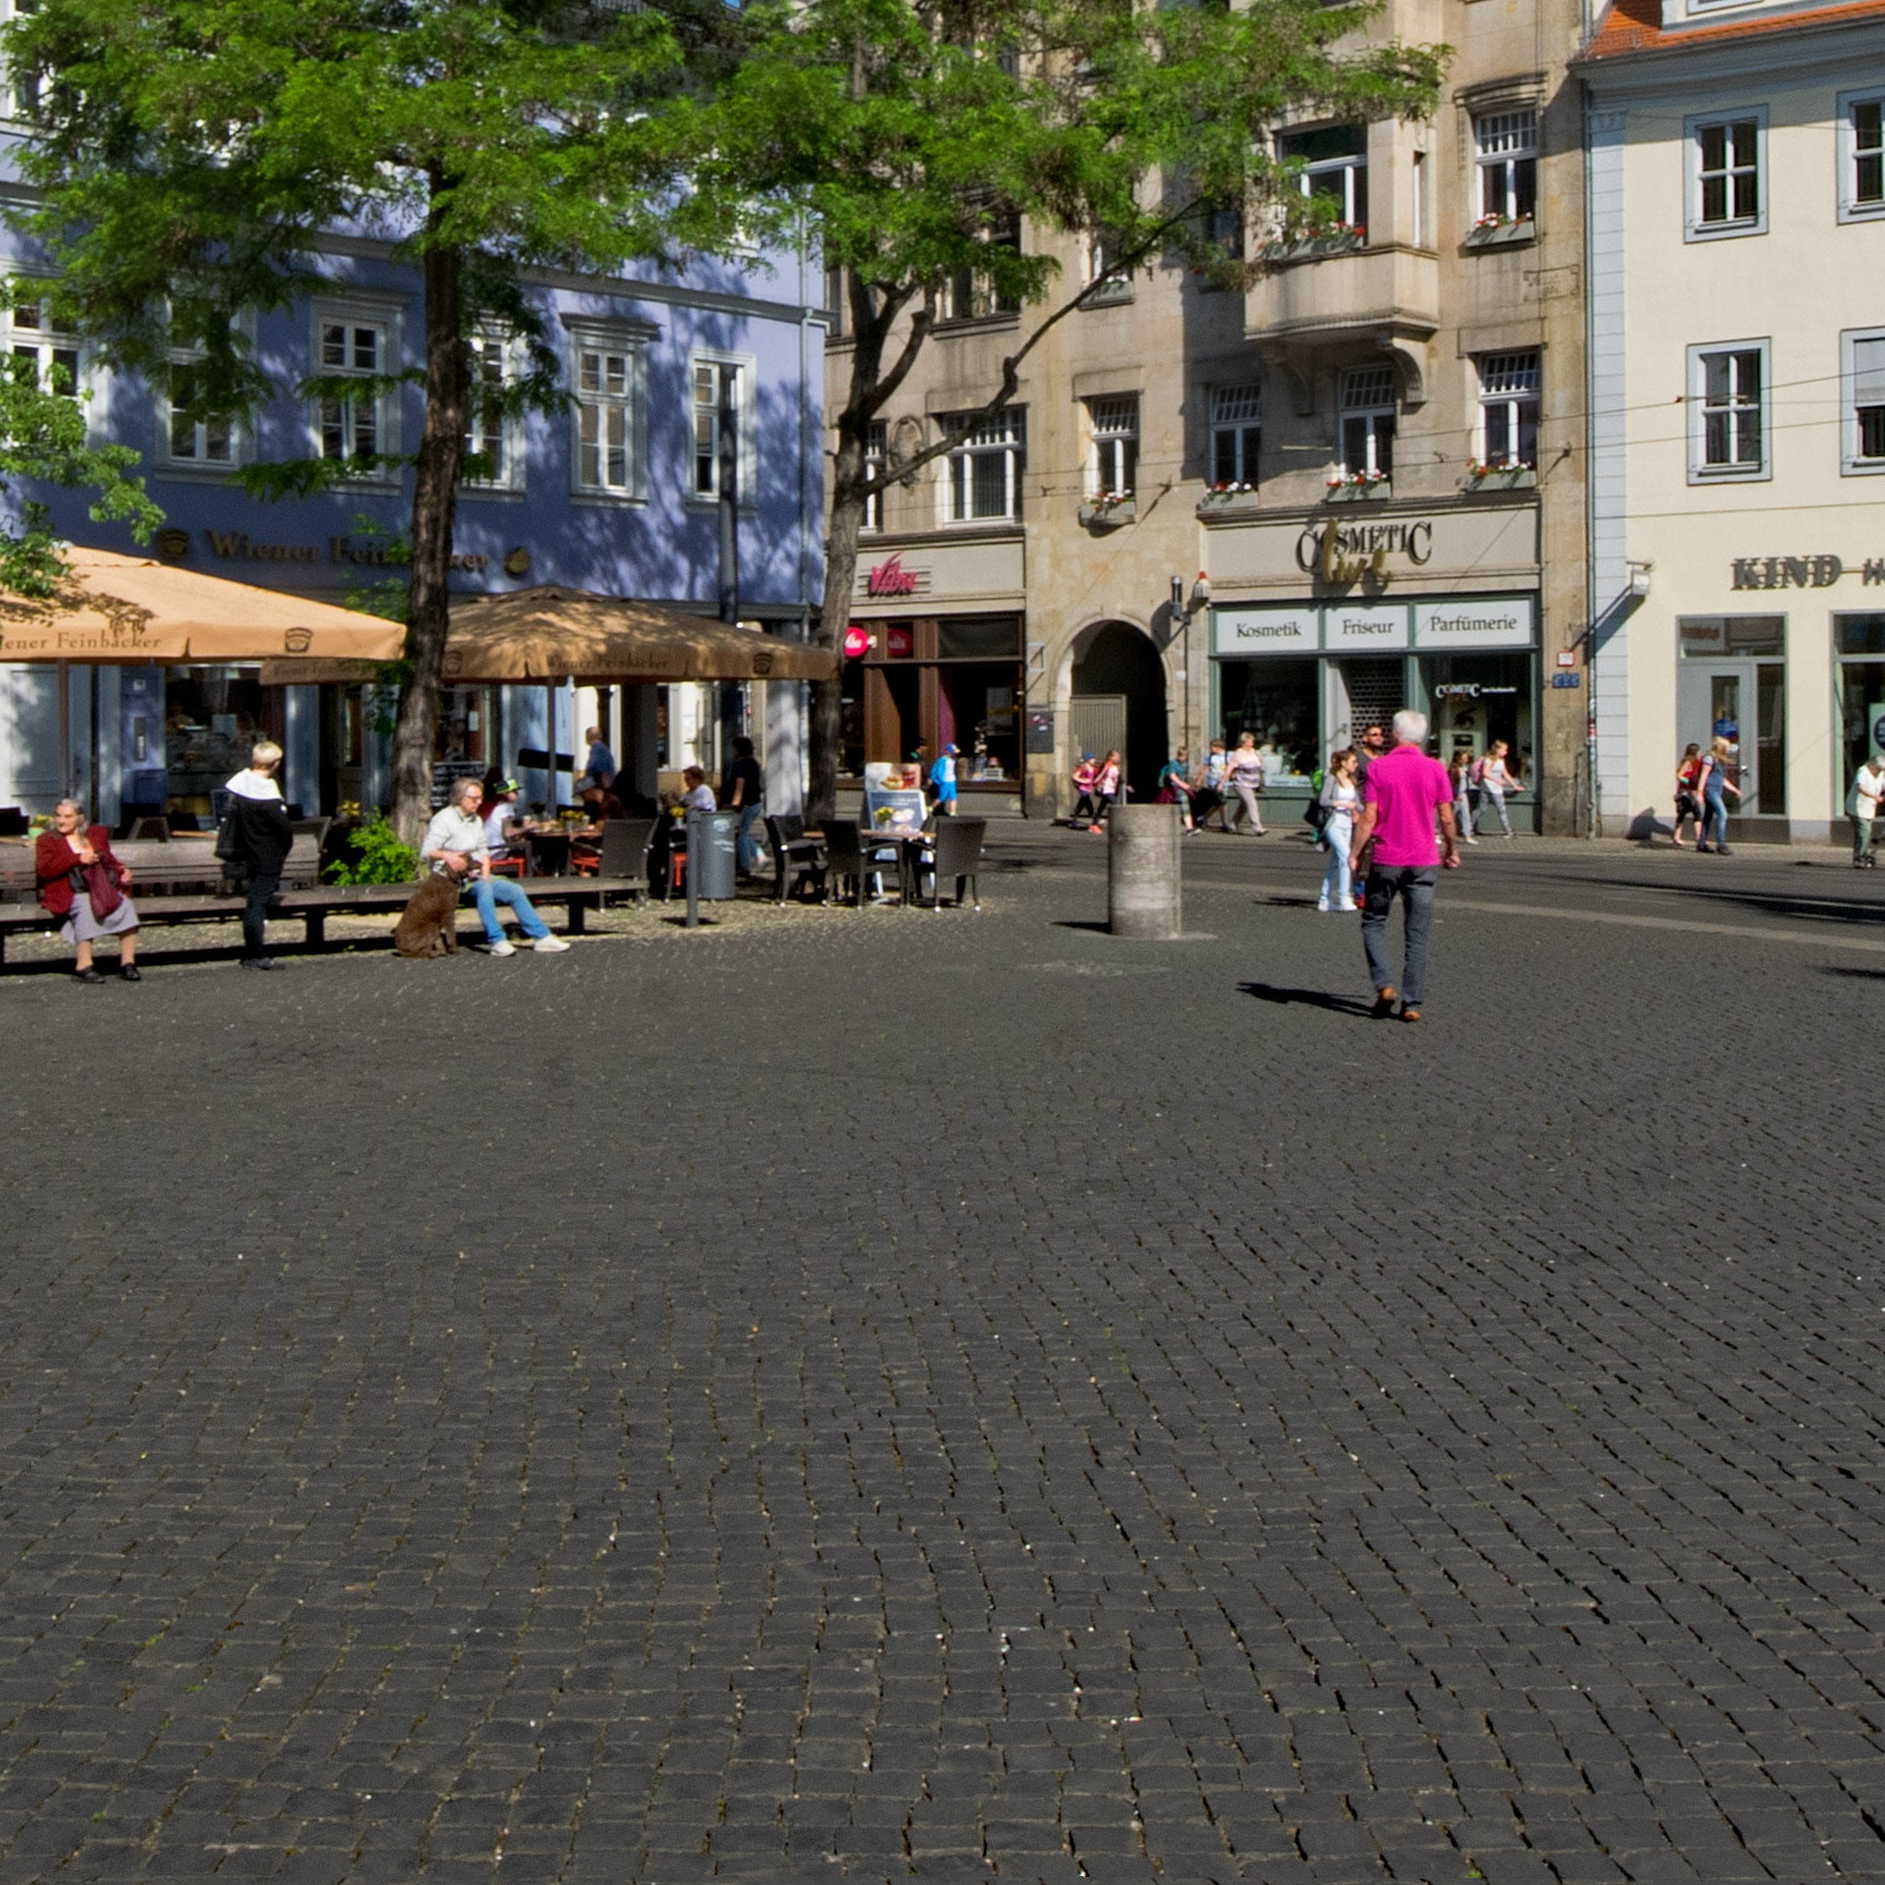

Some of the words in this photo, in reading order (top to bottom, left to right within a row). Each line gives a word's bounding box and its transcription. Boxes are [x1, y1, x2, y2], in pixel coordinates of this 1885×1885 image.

[204, 529, 320, 563] Wiener
[329, 535, 489, 571] Feiner
[1730, 555, 1843, 591] KIND
[1236, 622, 1302, 637] Kosmetik
[1342, 619, 1394, 634] Friseur
[1430, 615, 1517, 632] Parfümerie
